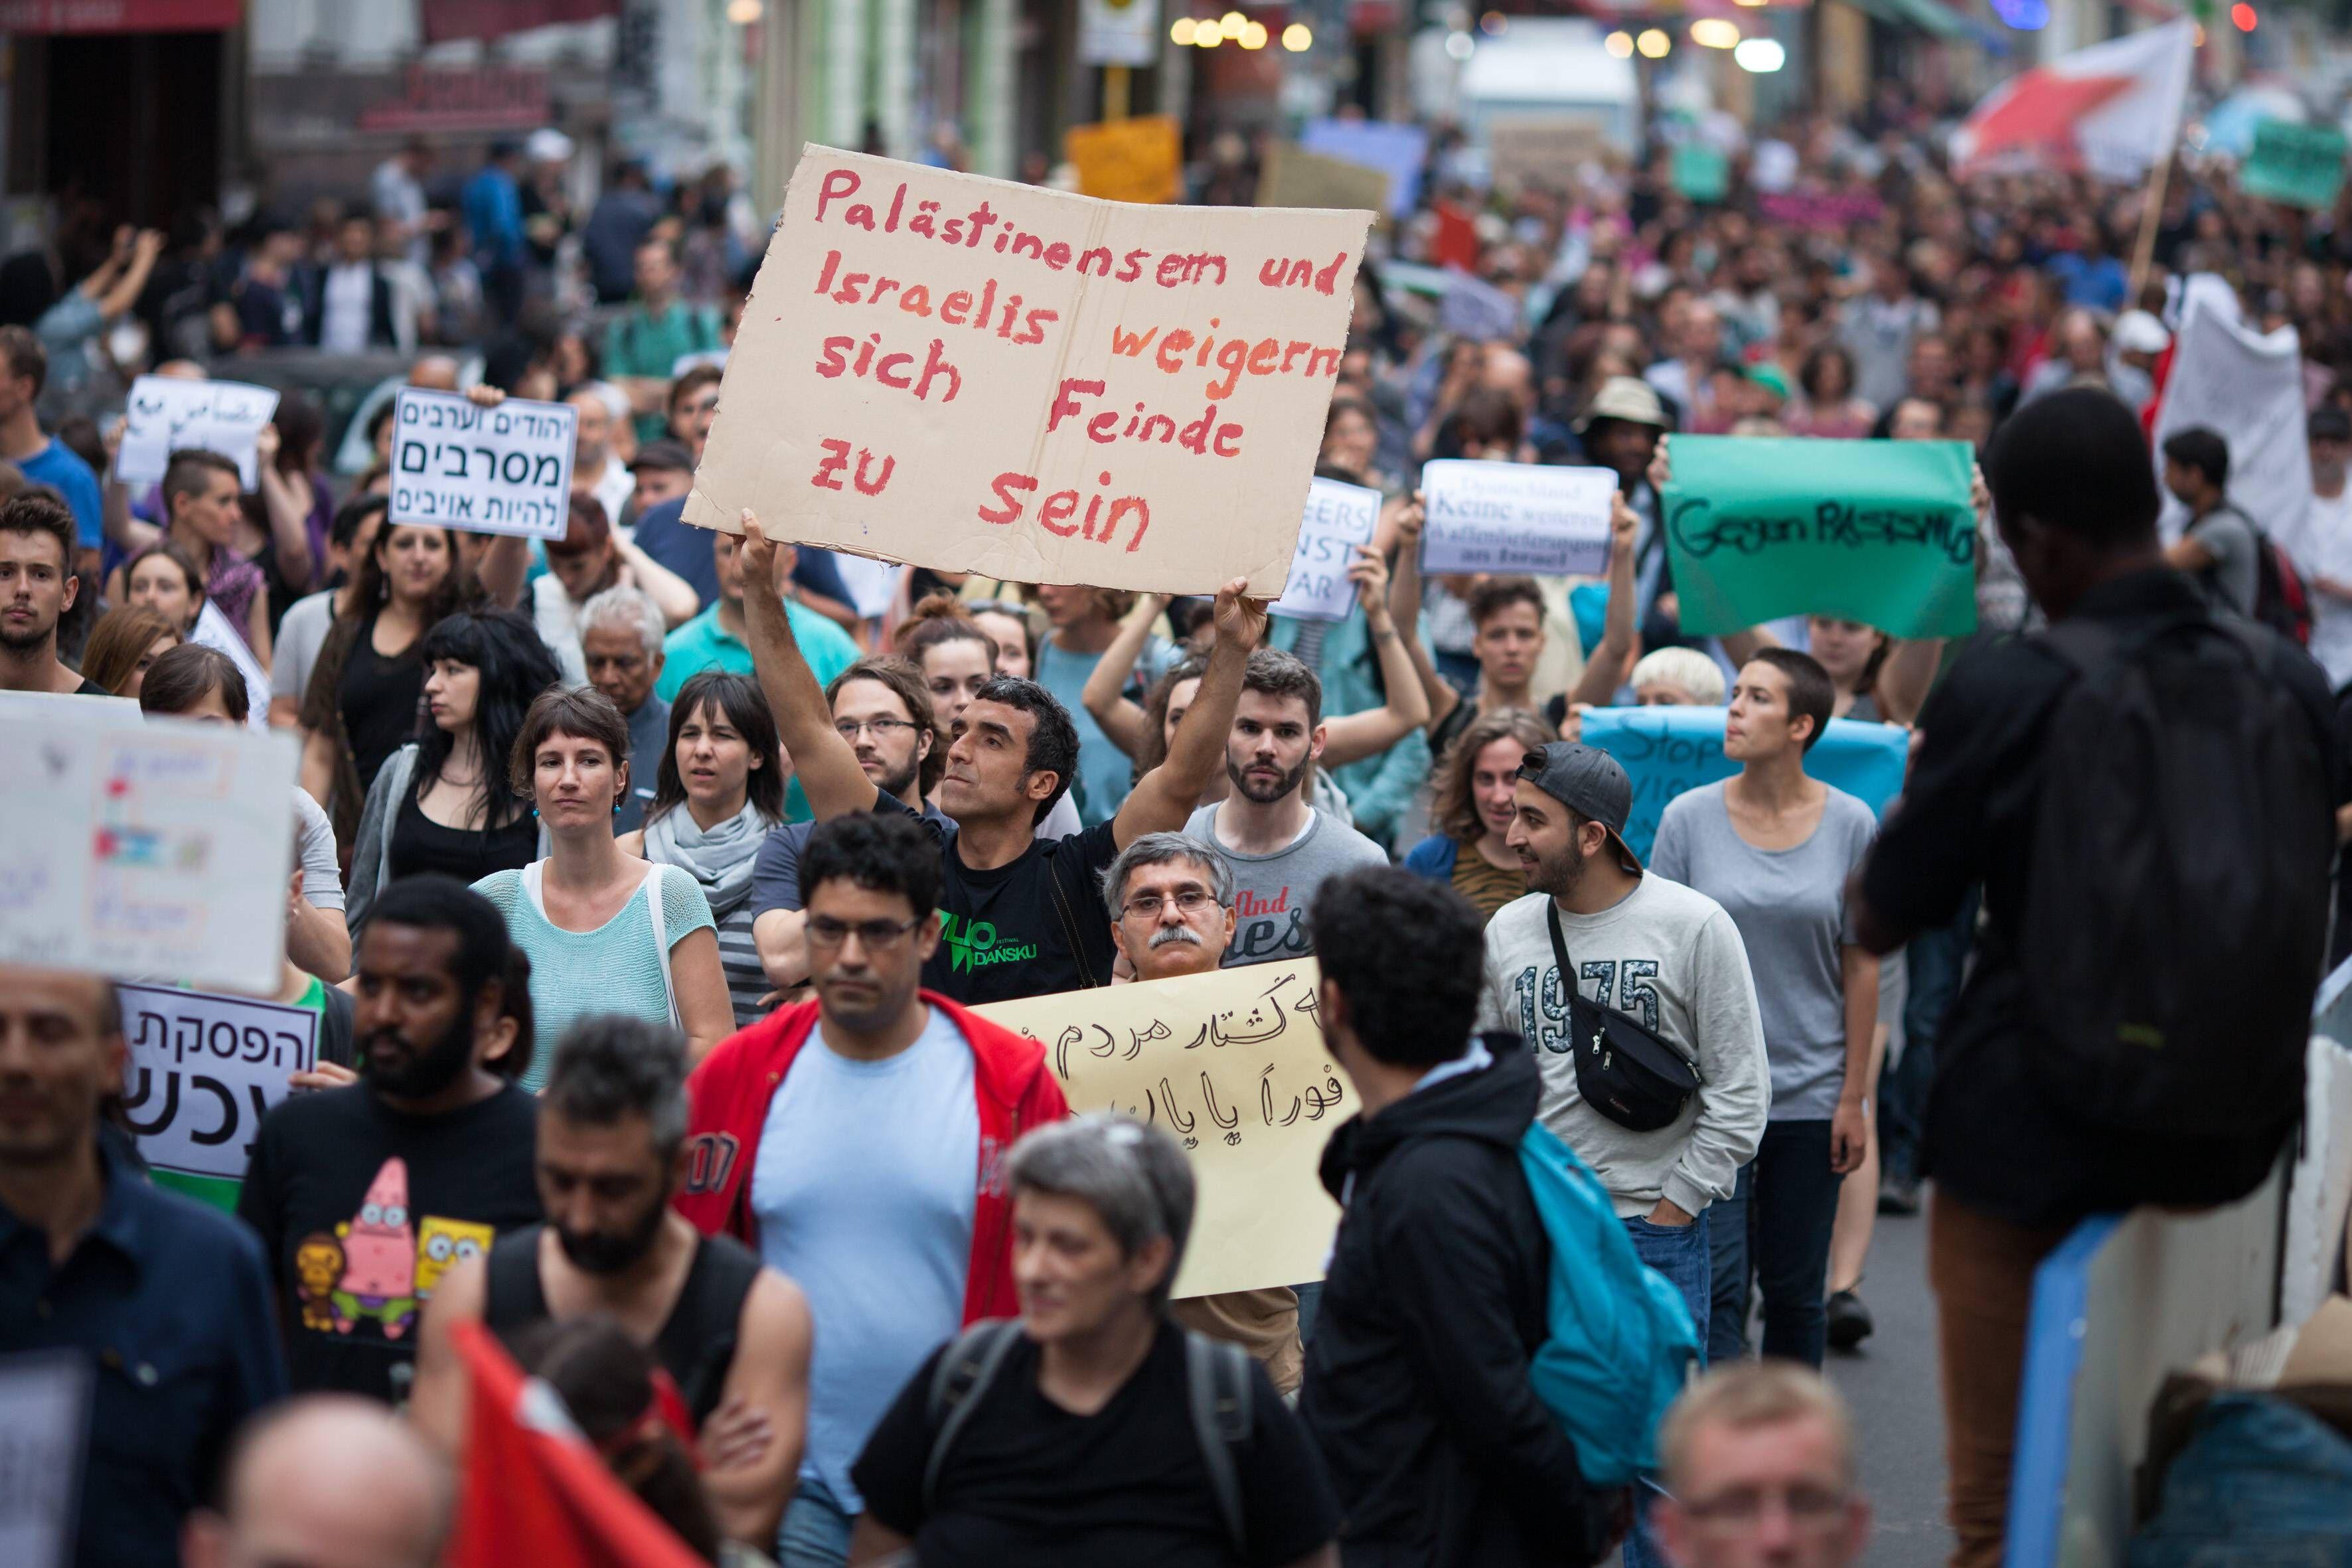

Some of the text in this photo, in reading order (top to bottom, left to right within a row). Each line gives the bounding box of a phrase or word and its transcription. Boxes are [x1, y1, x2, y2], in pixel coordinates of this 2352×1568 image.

[1259, 252, 1348, 296] und
[814, 250, 1342, 400] Israelis weigern
[816, 333, 1243, 457] sich Feinde
[401, 441, 560, 487] מסרבים
[485, 495, 558, 526] להיות
[1289, 571, 1333, 597] AR
[1515, 960, 1659, 1054] 1975
[133, 1011, 303, 1071] הפסקת
